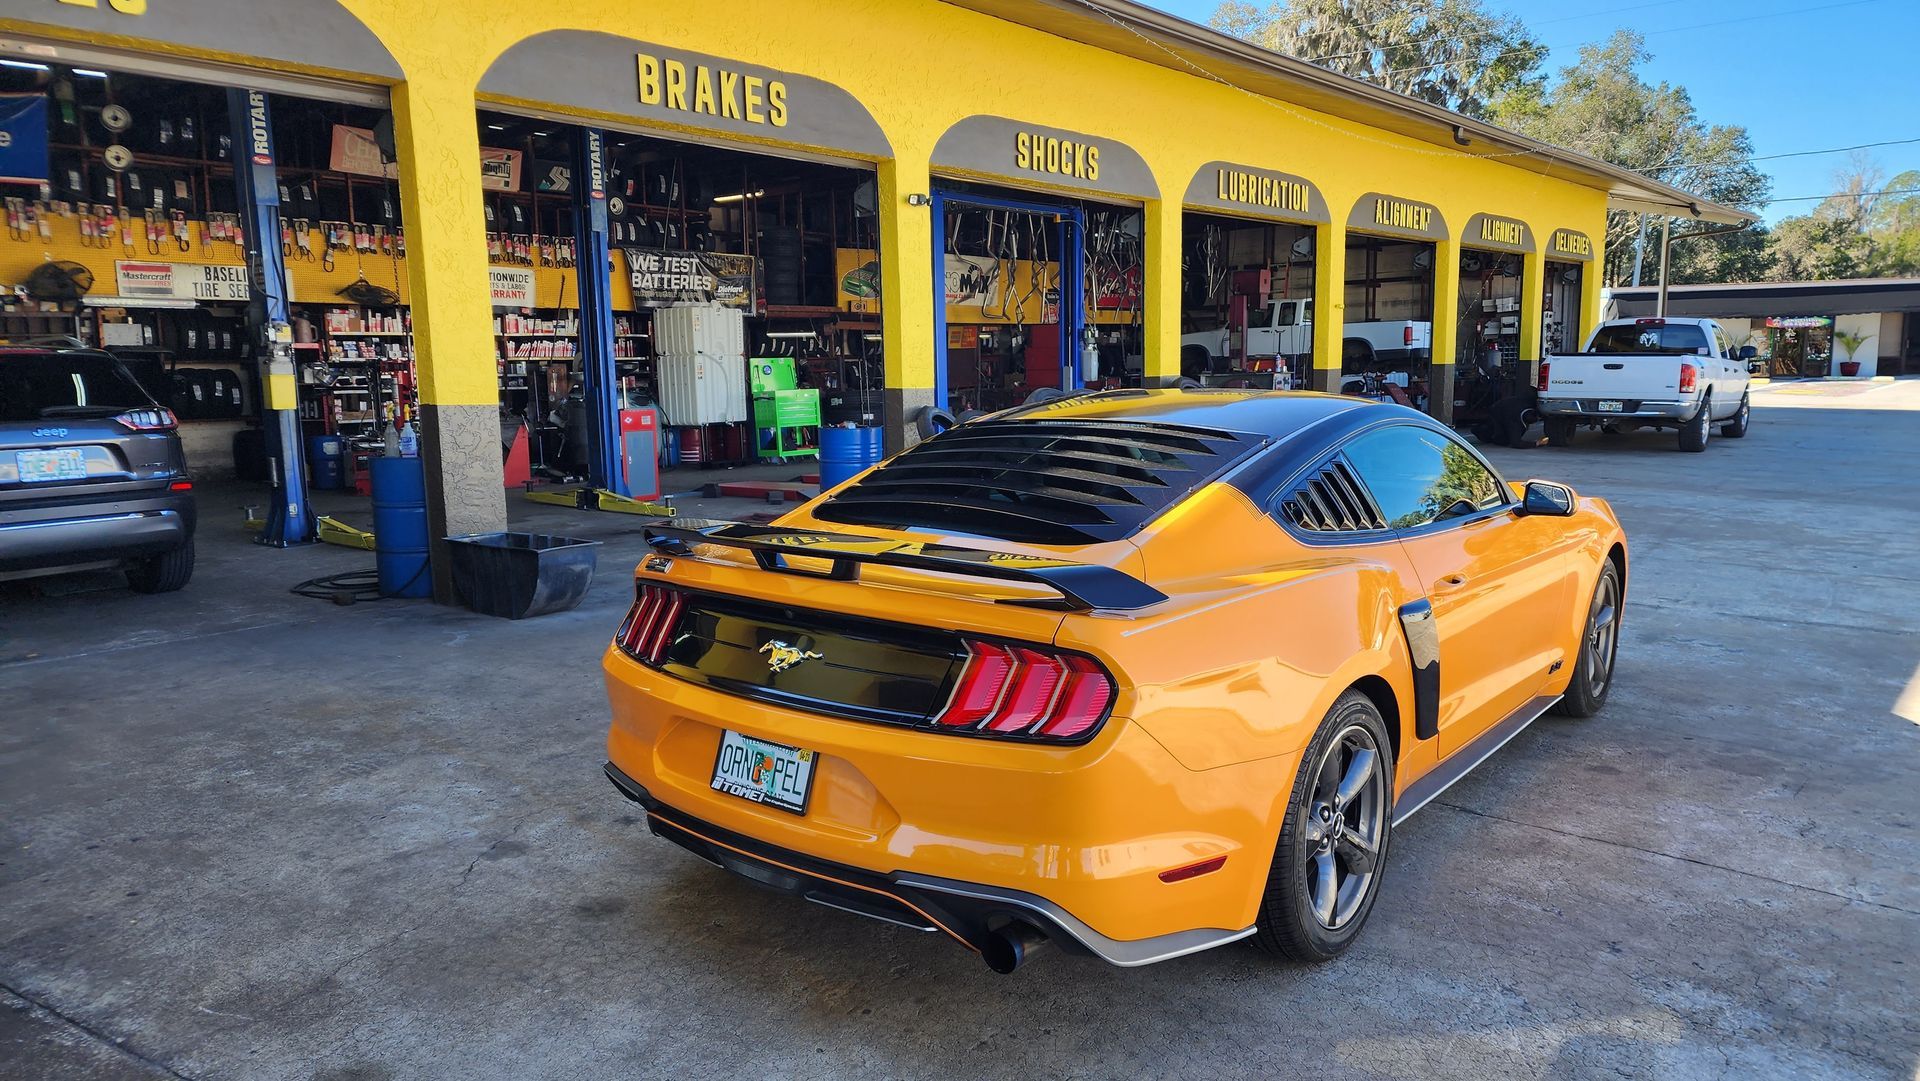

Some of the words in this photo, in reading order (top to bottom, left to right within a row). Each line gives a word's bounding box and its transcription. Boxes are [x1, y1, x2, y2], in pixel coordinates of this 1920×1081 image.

[637, 53, 788, 127] BRAKES
[590, 131, 603, 190] ROTARY
[1016, 132, 1099, 180] SHOCKS
[1218, 169, 1309, 213] LUBRICATION
[1375, 199, 1432, 232] ALIGNMENT
[1481, 218, 1524, 245] ALIGNMENT
[1555, 232, 1590, 256] DELIVERIES
[632, 254, 659, 271] WE
[662, 257, 700, 273] TEST
[122, 271, 171, 281] Mastercraft
[632, 272, 712, 290] BATTERIES
[193, 282, 219, 298] TIRE
[717, 285, 744, 293] DieHard
[32, 427, 68, 438] Jeep
[770, 757, 802, 796] PEL
[721, 781, 765, 803] TOMEI
